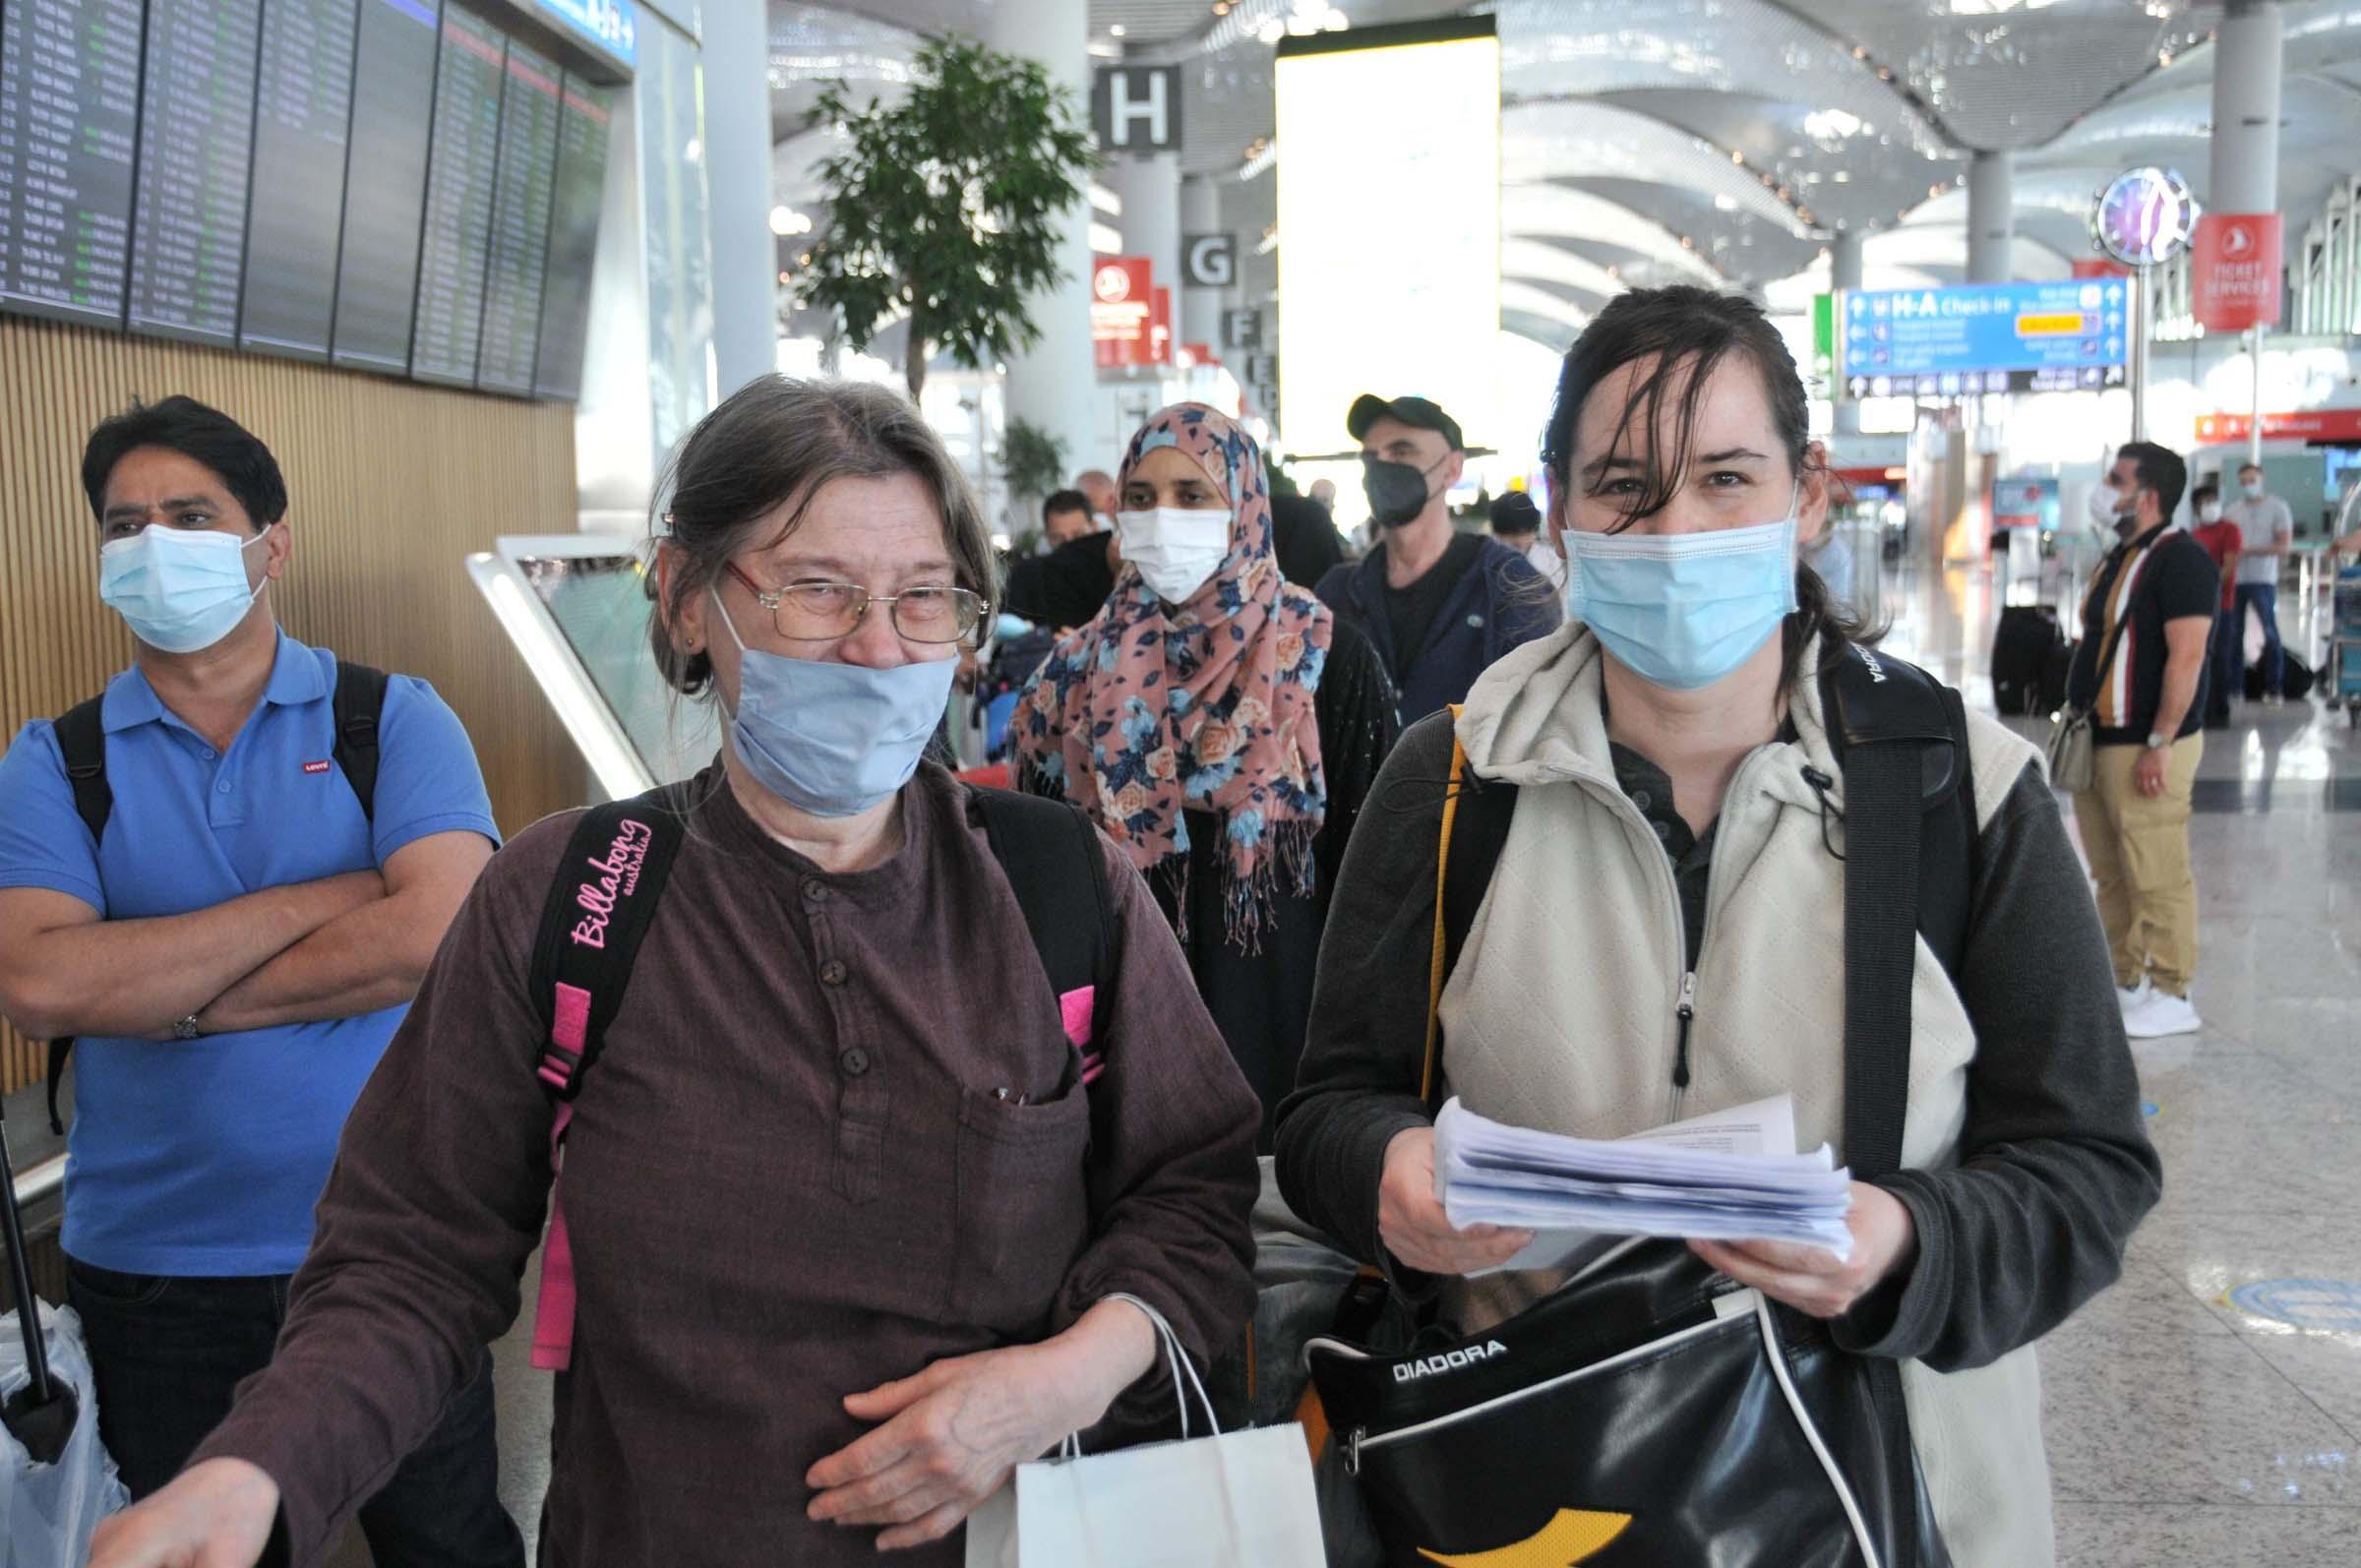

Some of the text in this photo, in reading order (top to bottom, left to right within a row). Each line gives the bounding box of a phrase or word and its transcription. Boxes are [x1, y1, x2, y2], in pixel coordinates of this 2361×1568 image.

[1111, 71, 1168, 145] H
[1189, 237, 1231, 285] G
[1892, 292, 1936, 317] H-A
[1942, 296, 2010, 316] Check-in
[572, 819, 651, 948] Billabong
[1393, 1340, 1506, 1381] DIADORA
